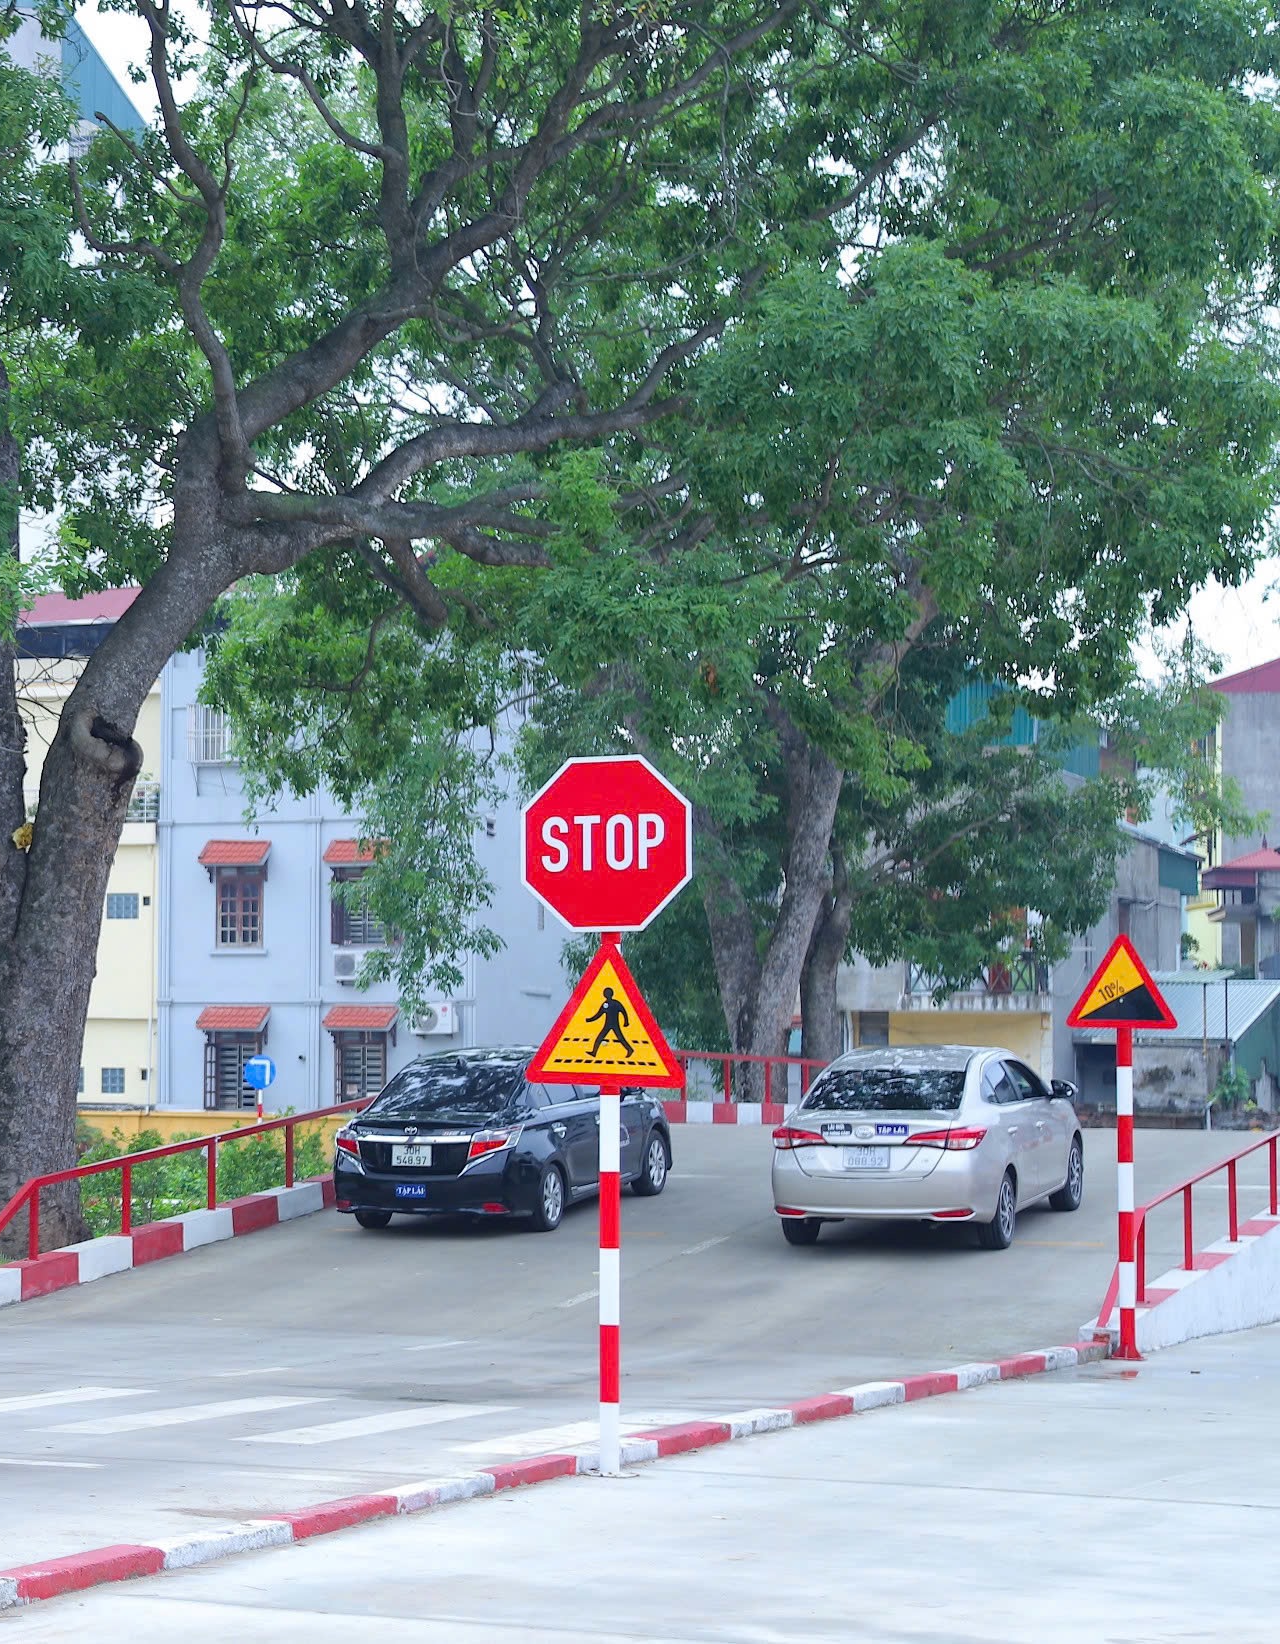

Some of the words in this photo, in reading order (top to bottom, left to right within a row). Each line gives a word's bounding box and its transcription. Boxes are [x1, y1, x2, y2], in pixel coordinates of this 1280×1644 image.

[541, 813, 665, 872] STOP
[1098, 980, 1125, 1001] 10%
[404, 1146, 420, 1155] 30H
